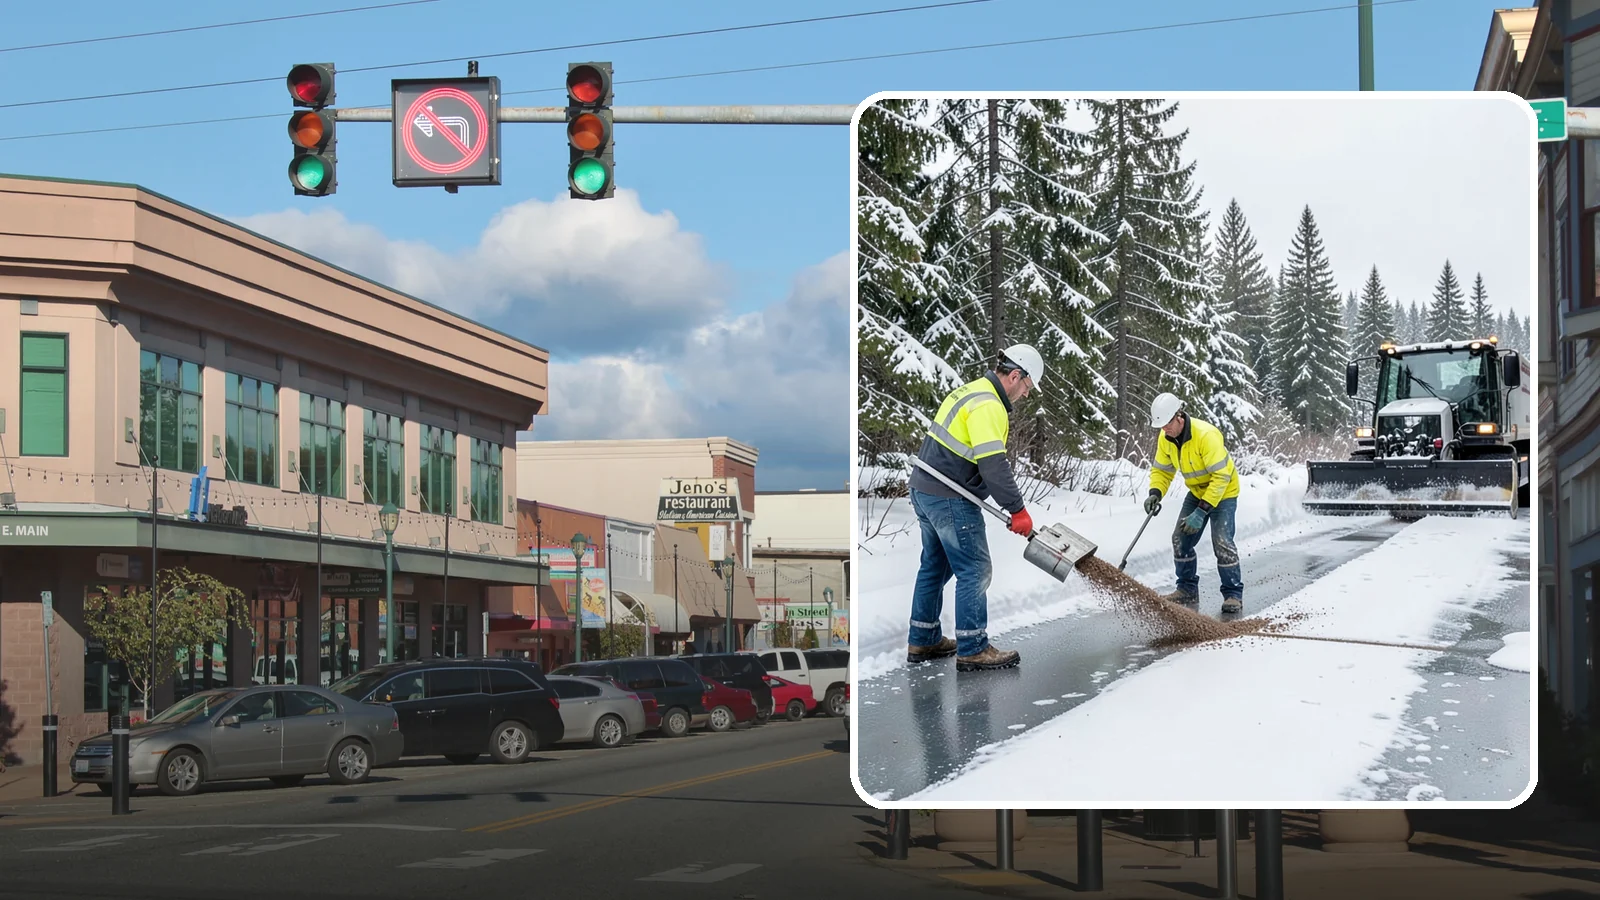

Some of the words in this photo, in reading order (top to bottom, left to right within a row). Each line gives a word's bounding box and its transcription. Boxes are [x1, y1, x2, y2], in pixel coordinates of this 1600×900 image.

[669, 480, 728, 494] Jeno's
[665, 496, 731, 509] restaurant
[658, 510, 681, 519] Italian
[686, 509, 714, 519] American
[715, 509, 737, 519] Cuisine
[2, 525, 13, 536] E.
[15, 525, 49, 536] MAIN
[797, 608, 829, 617] Street
[791, 619, 824, 627] lass
